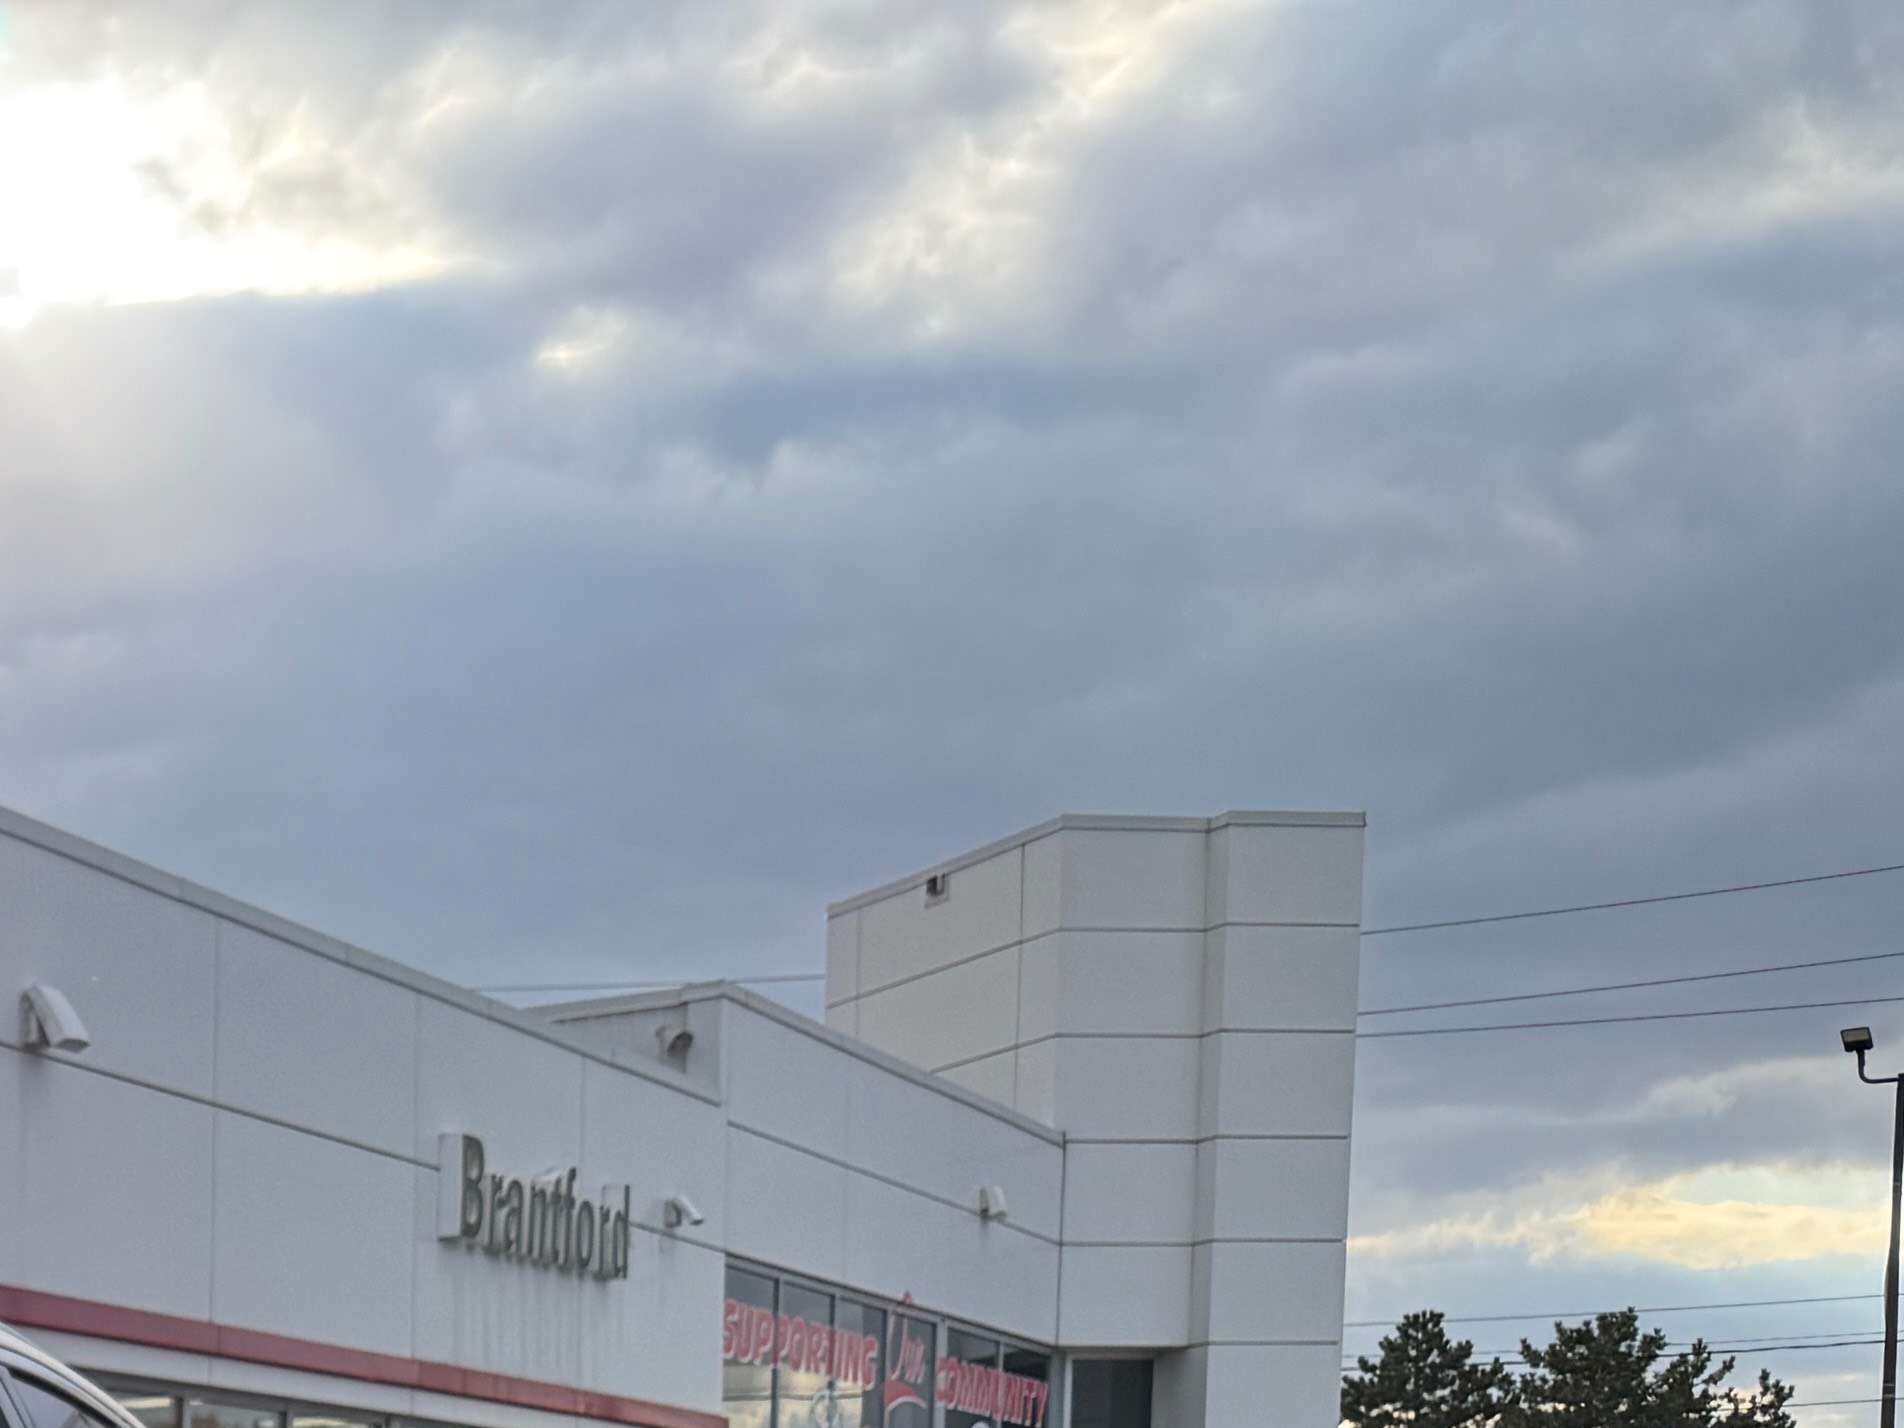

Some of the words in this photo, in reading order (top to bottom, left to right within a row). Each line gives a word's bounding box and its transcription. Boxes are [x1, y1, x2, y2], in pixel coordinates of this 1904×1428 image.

[442, 1133, 630, 1280] Brantford
[722, 1298, 879, 1390] SUPPORTING
[935, 1356, 1049, 1428] COMMUNITY
